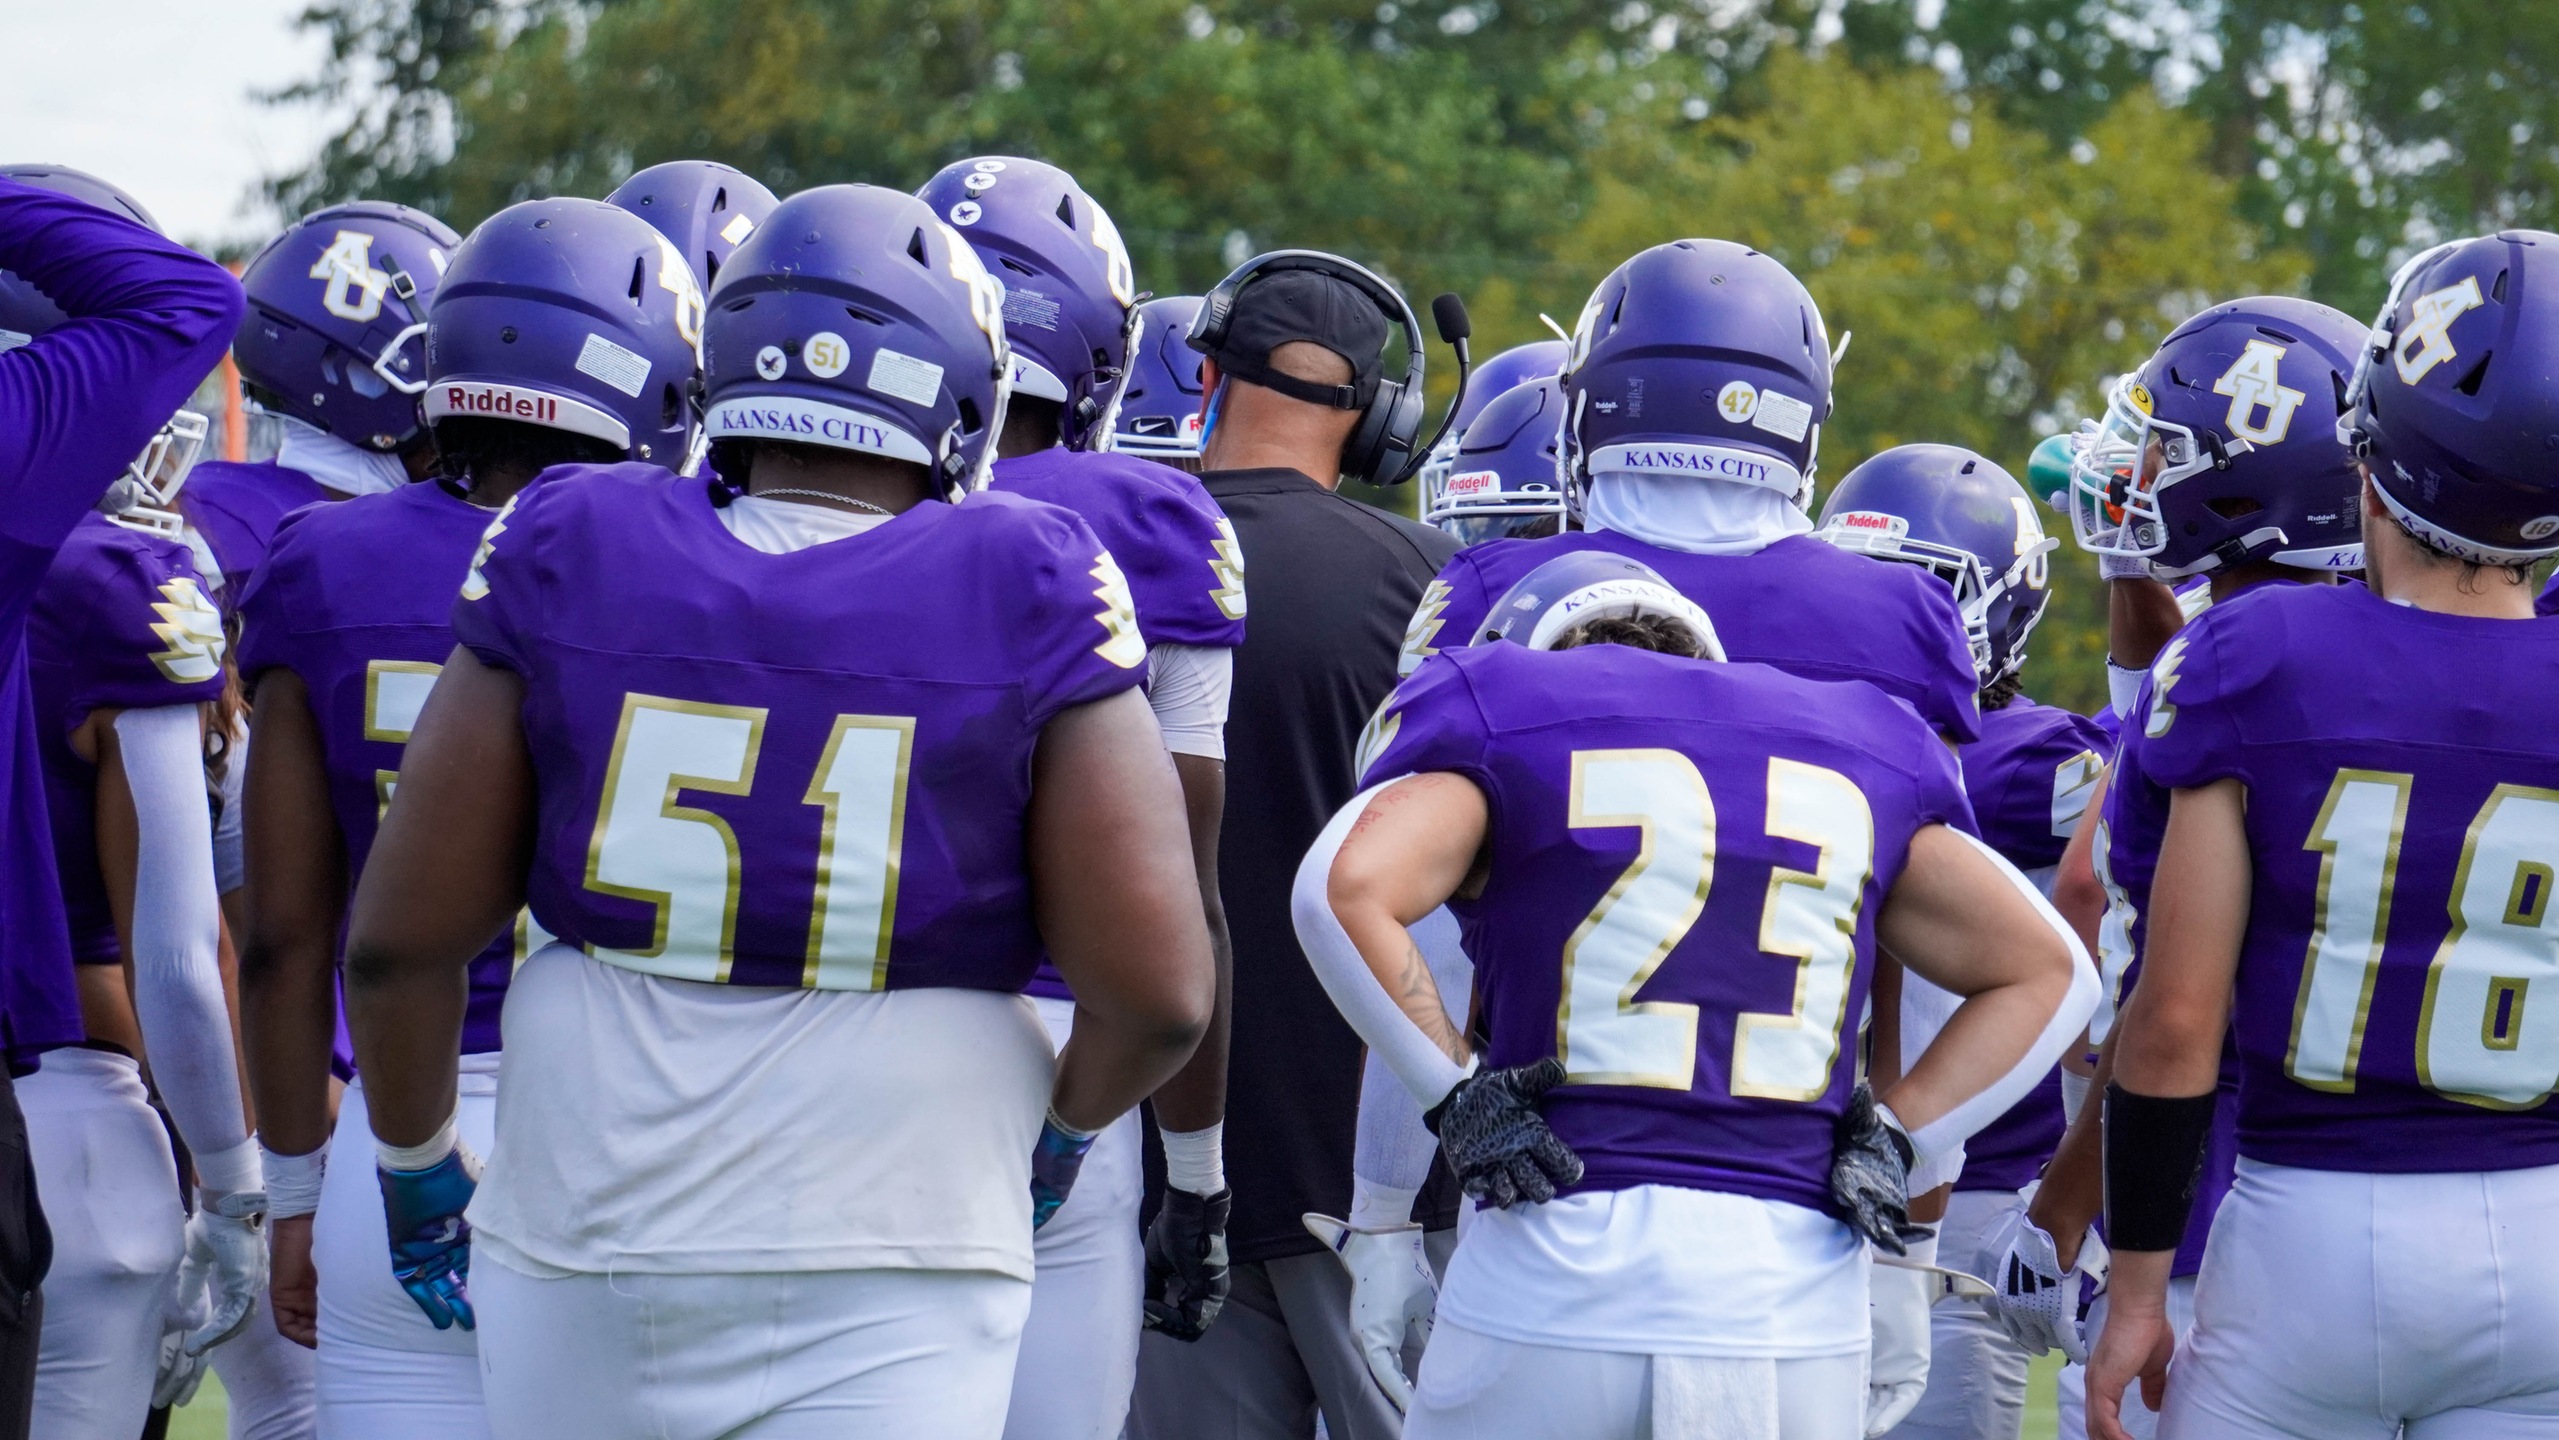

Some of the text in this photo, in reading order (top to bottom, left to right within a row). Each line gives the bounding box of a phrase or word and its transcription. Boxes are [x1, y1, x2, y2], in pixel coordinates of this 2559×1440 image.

[309, 230, 392, 323] AU
[2393, 275, 2485, 387] AU
[609, 343, 634, 359] WARNING
[812, 340, 841, 370] 51
[448, 387, 557, 422] Riddell
[1723, 390, 1754, 414] 47
[2212, 338, 2306, 446] AU
[722, 409, 889, 449] KANSAS CITY
[1448, 475, 1490, 491] Riddell
[1625, 451, 1772, 482] KANSAS CITY
[1845, 514, 1890, 529] Riddell
[2525, 521, 2557, 536] 18
[1565, 584, 1665, 613] KANSAS
[582, 691, 917, 993] 51
[1556, 747, 1874, 1103] 23
[2284, 767, 2559, 1112] 18
